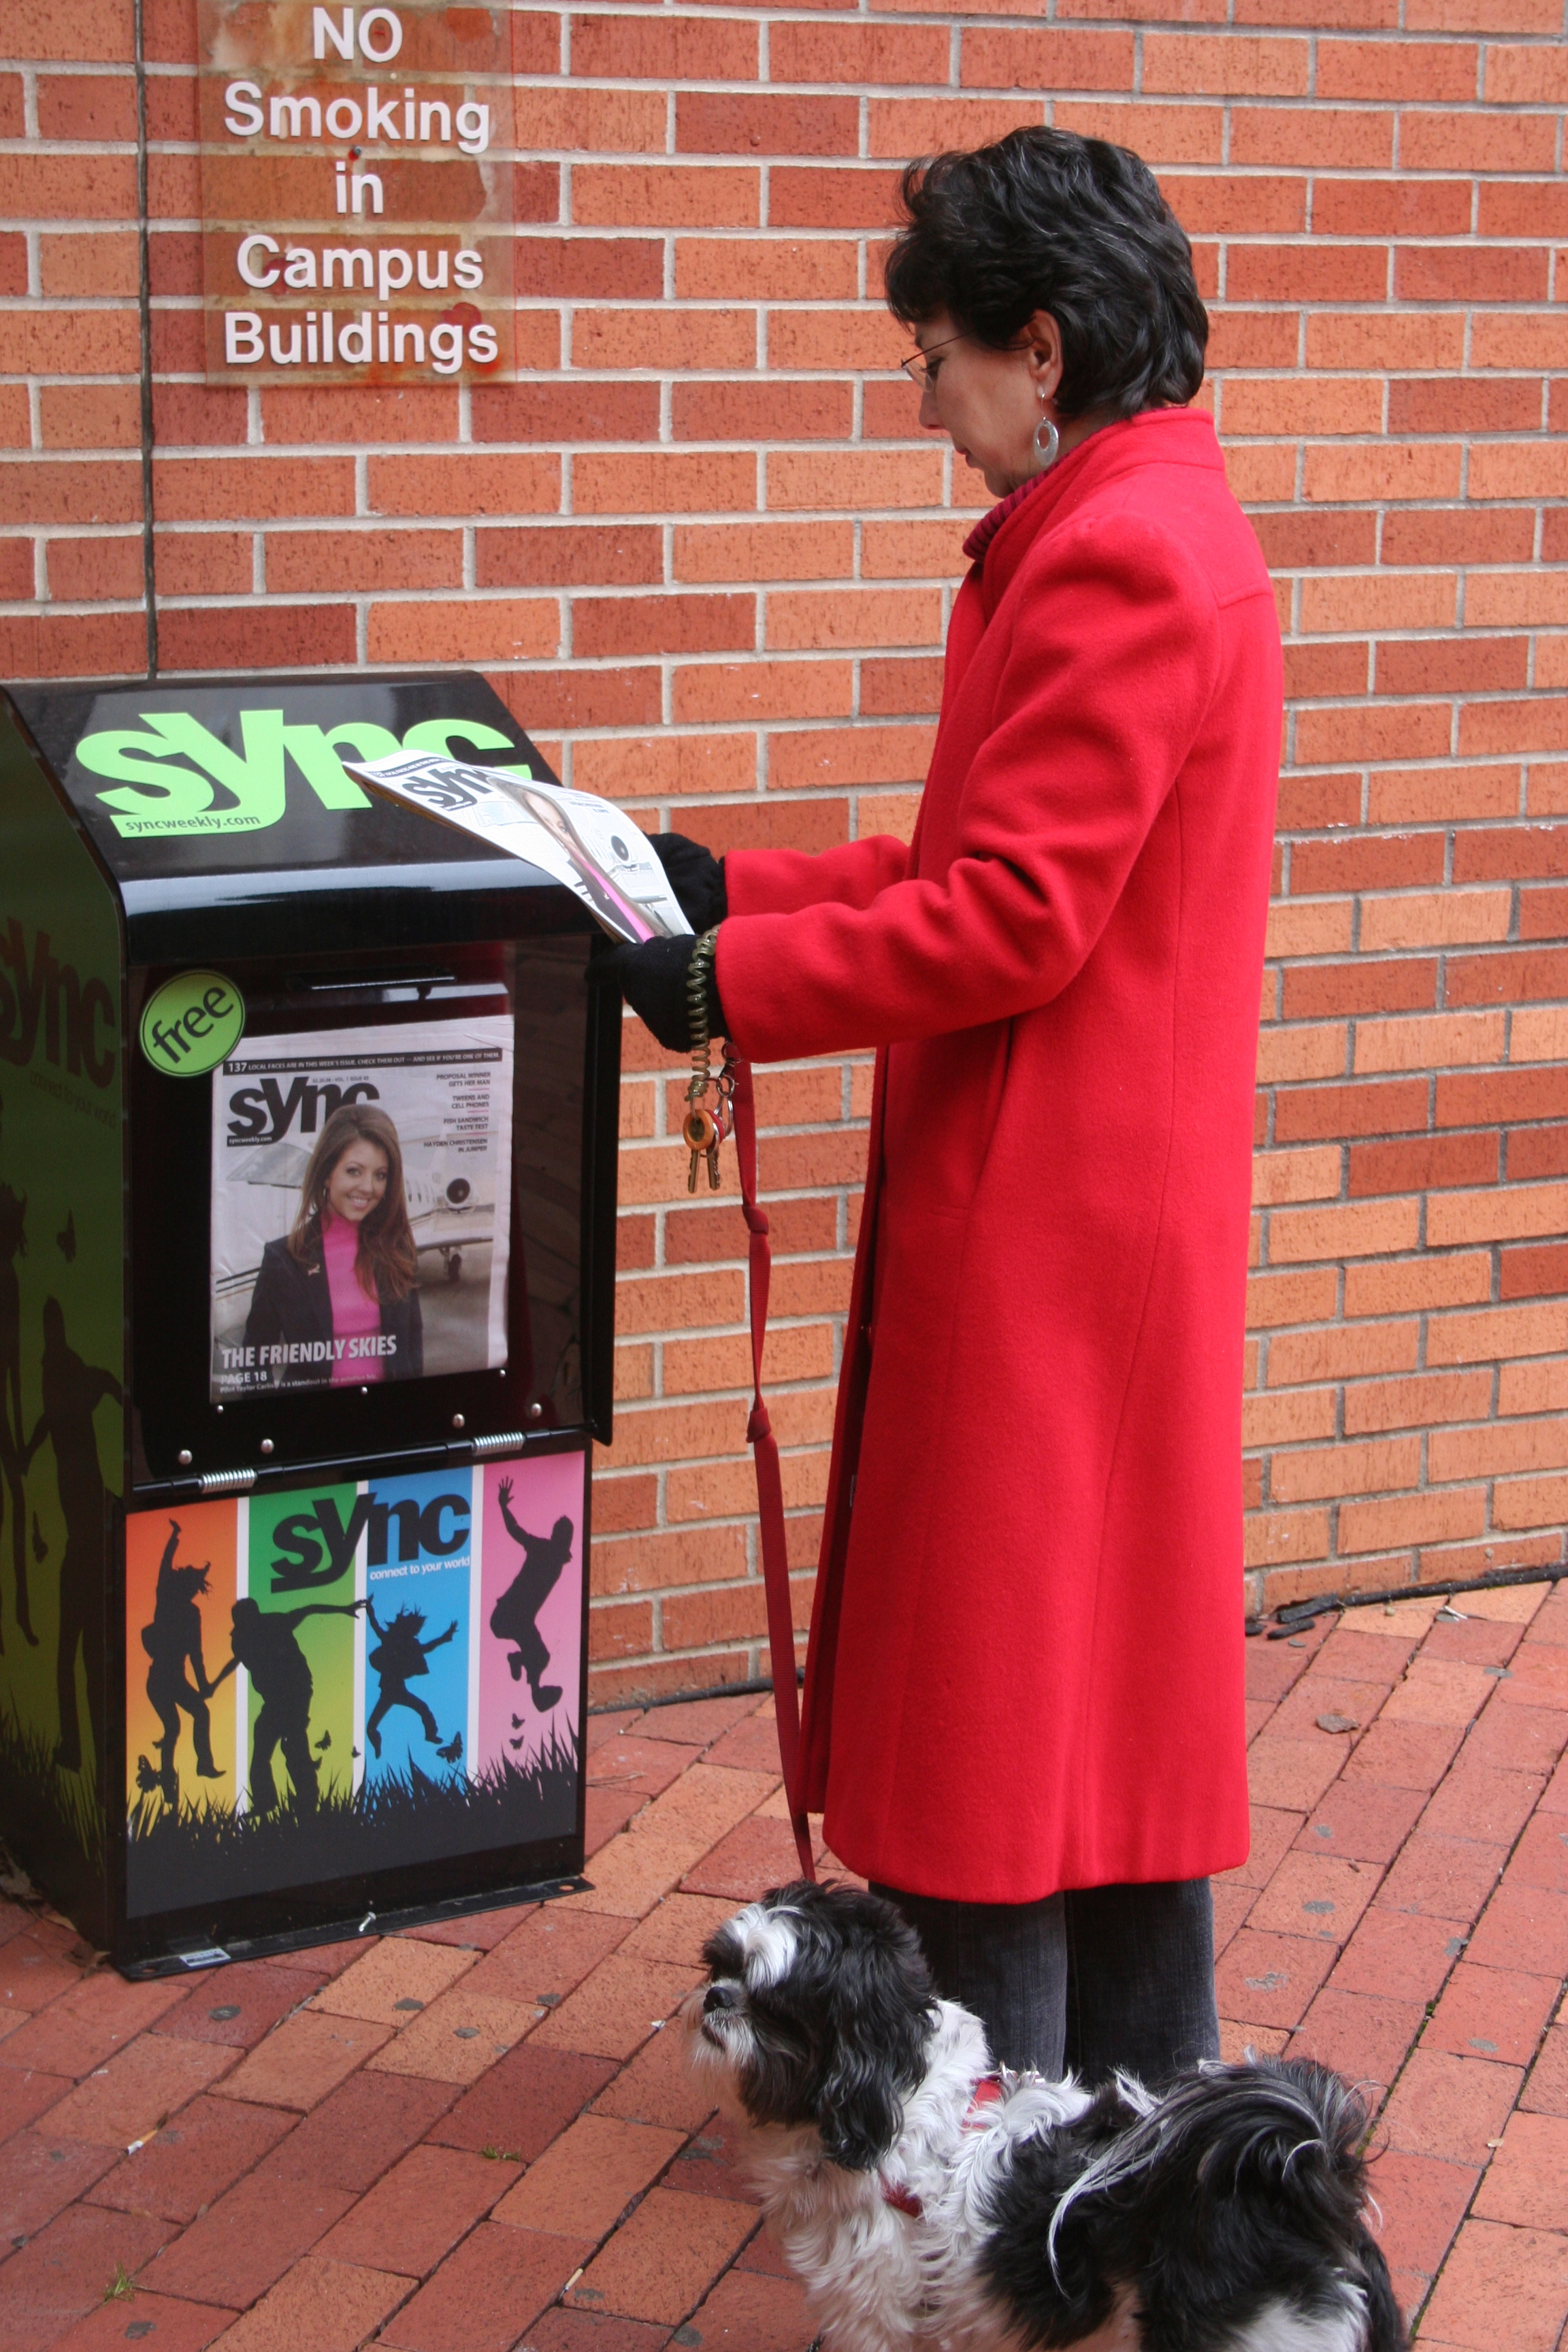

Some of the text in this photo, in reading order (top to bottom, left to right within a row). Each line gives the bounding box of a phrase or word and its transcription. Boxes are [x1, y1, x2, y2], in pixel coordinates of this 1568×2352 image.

[312, 7, 402, 63] NO
[225, 81, 489, 154] Smoking
[336, 161, 384, 214] in
[237, 234, 484, 301] Campus
[225, 311, 498, 374] Buildings
[125, 815, 261, 833] syncweekly.com
[151, 986, 235, 1064] free
[228, 1062, 248, 1073] 137
[220, 1371, 267, 1384] PAGE 18
[221, 1335, 397, 1369] THE FRIENDLY SKIES
[236, 1384, 256, 1392] Taylor
[270, 1492, 471, 1594] sync
[370, 1556, 470, 1580] connect to your world
